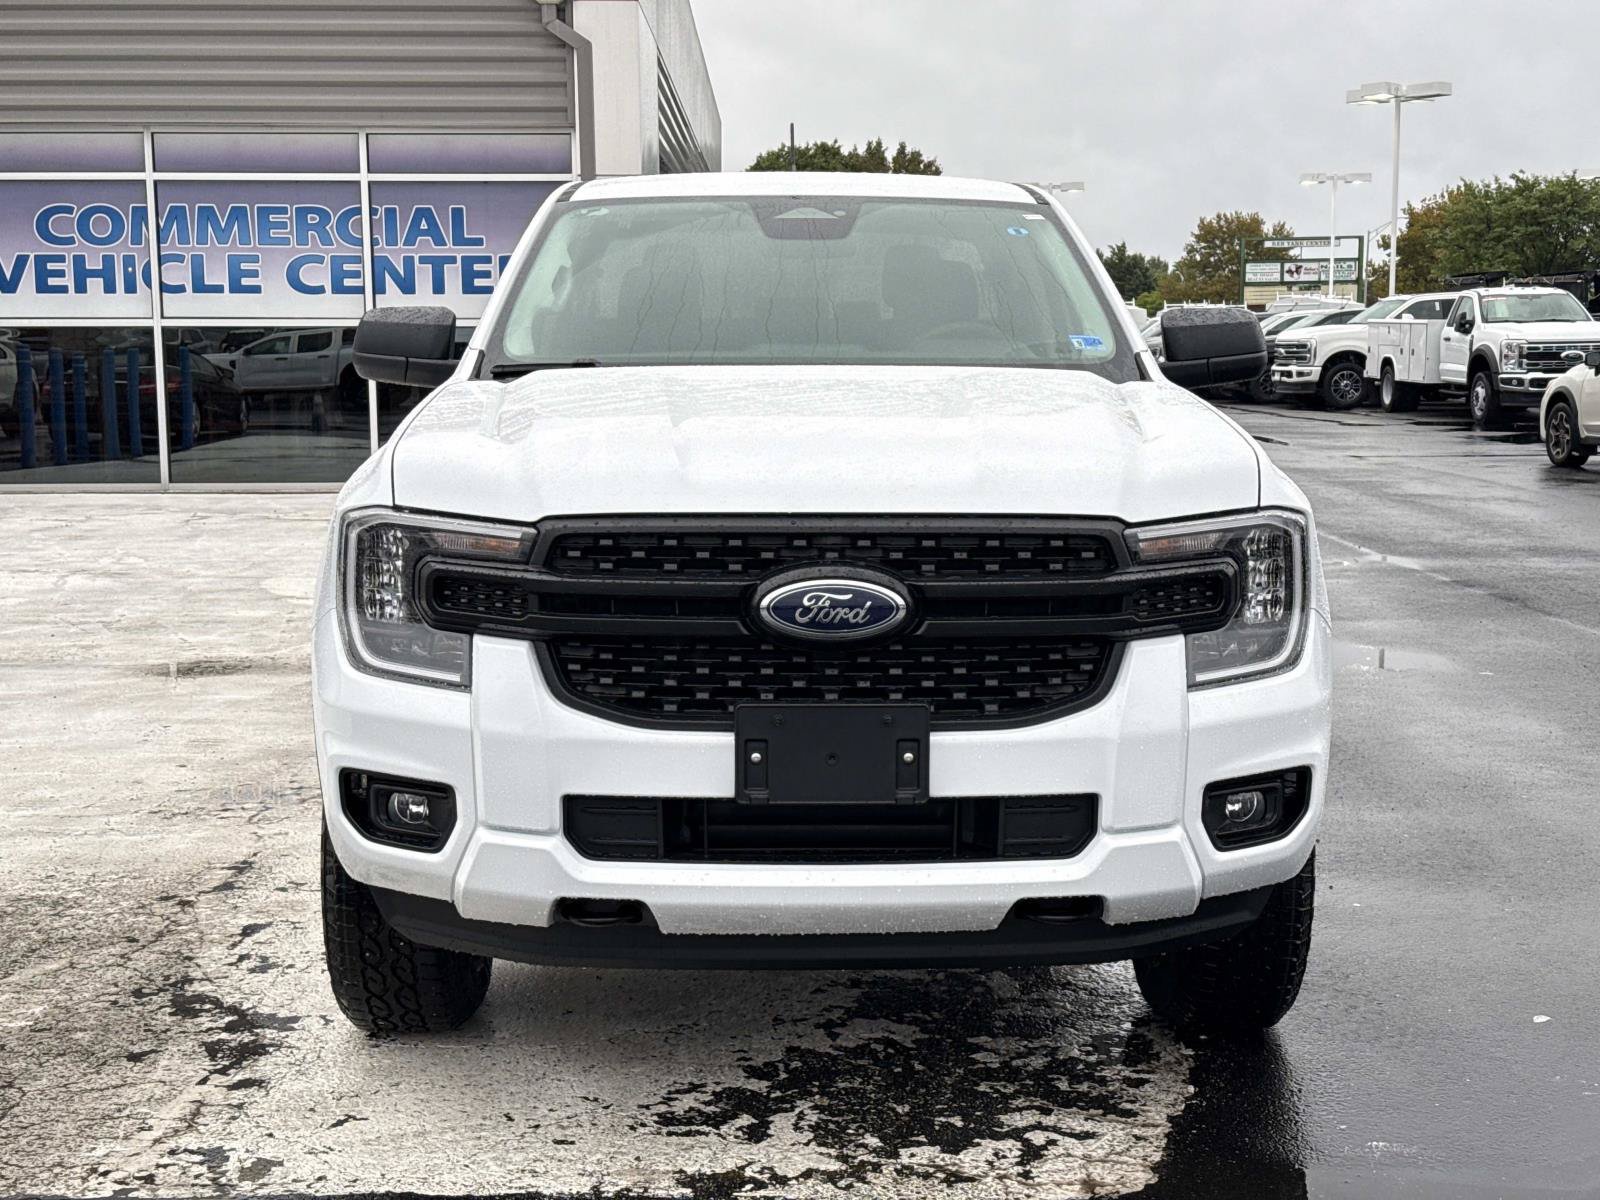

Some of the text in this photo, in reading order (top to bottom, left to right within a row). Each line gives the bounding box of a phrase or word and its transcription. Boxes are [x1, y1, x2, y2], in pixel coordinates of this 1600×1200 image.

[34, 203, 485, 248] COMMERCIAL
[0, 252, 263, 295] VEHICLE
[795, 592, 872, 624] Ford
